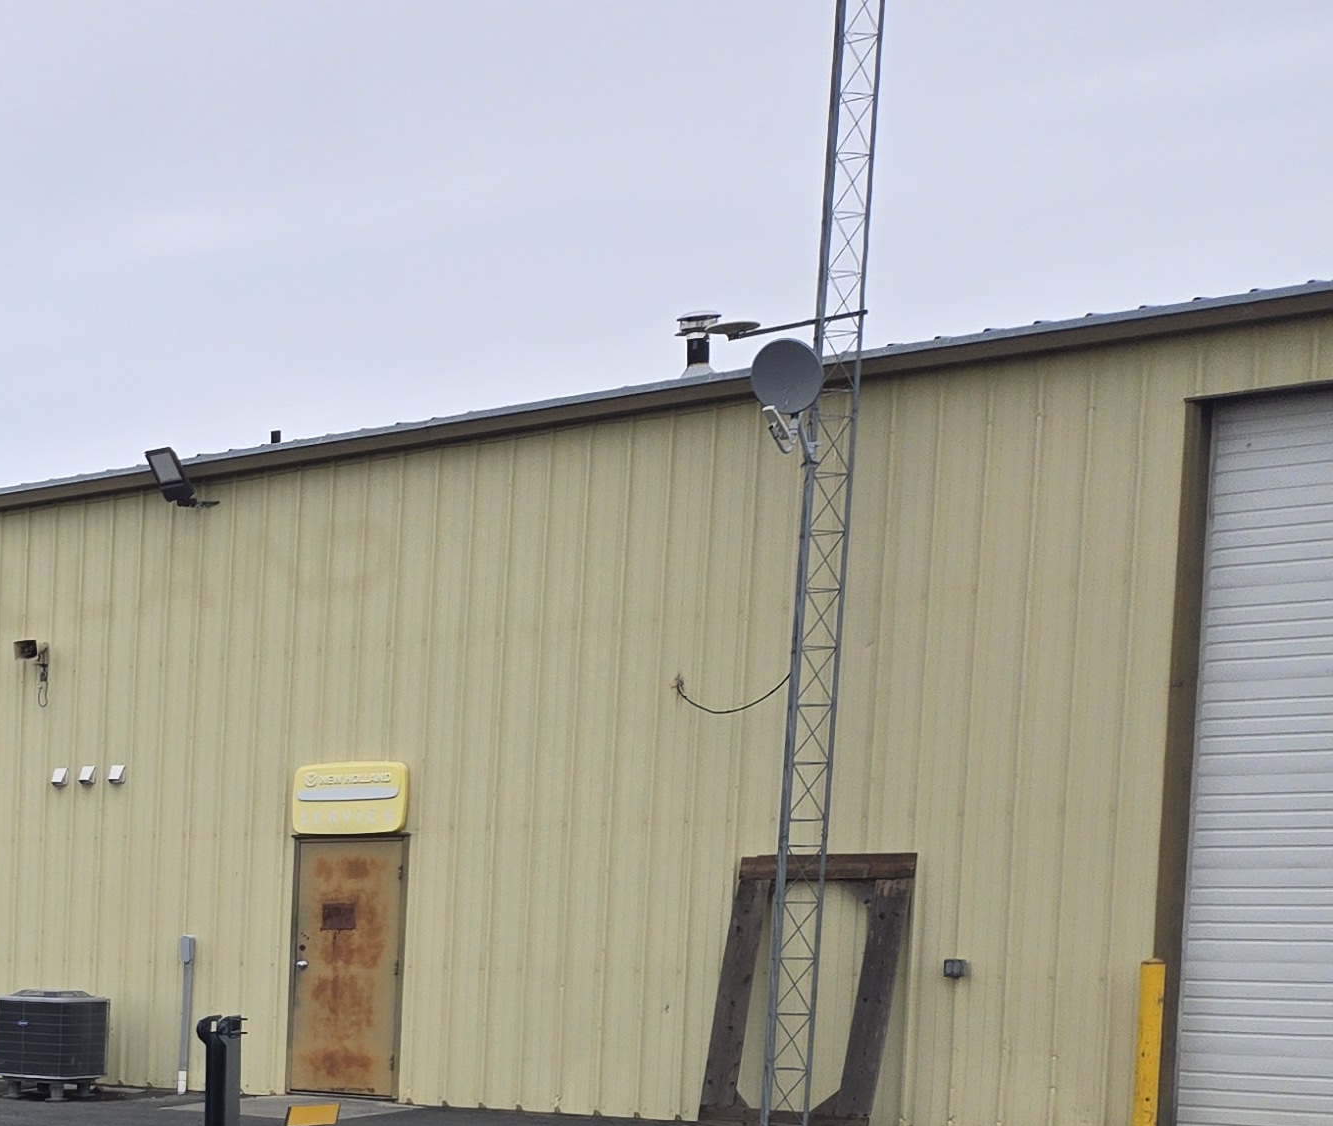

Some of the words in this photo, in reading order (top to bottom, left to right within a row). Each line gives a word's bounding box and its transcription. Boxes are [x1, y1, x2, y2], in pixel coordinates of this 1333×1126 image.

[319, 774, 342, 785] NEW
[344, 772, 392, 784] HOLLAND
[299, 808, 394, 826] SERVICE
